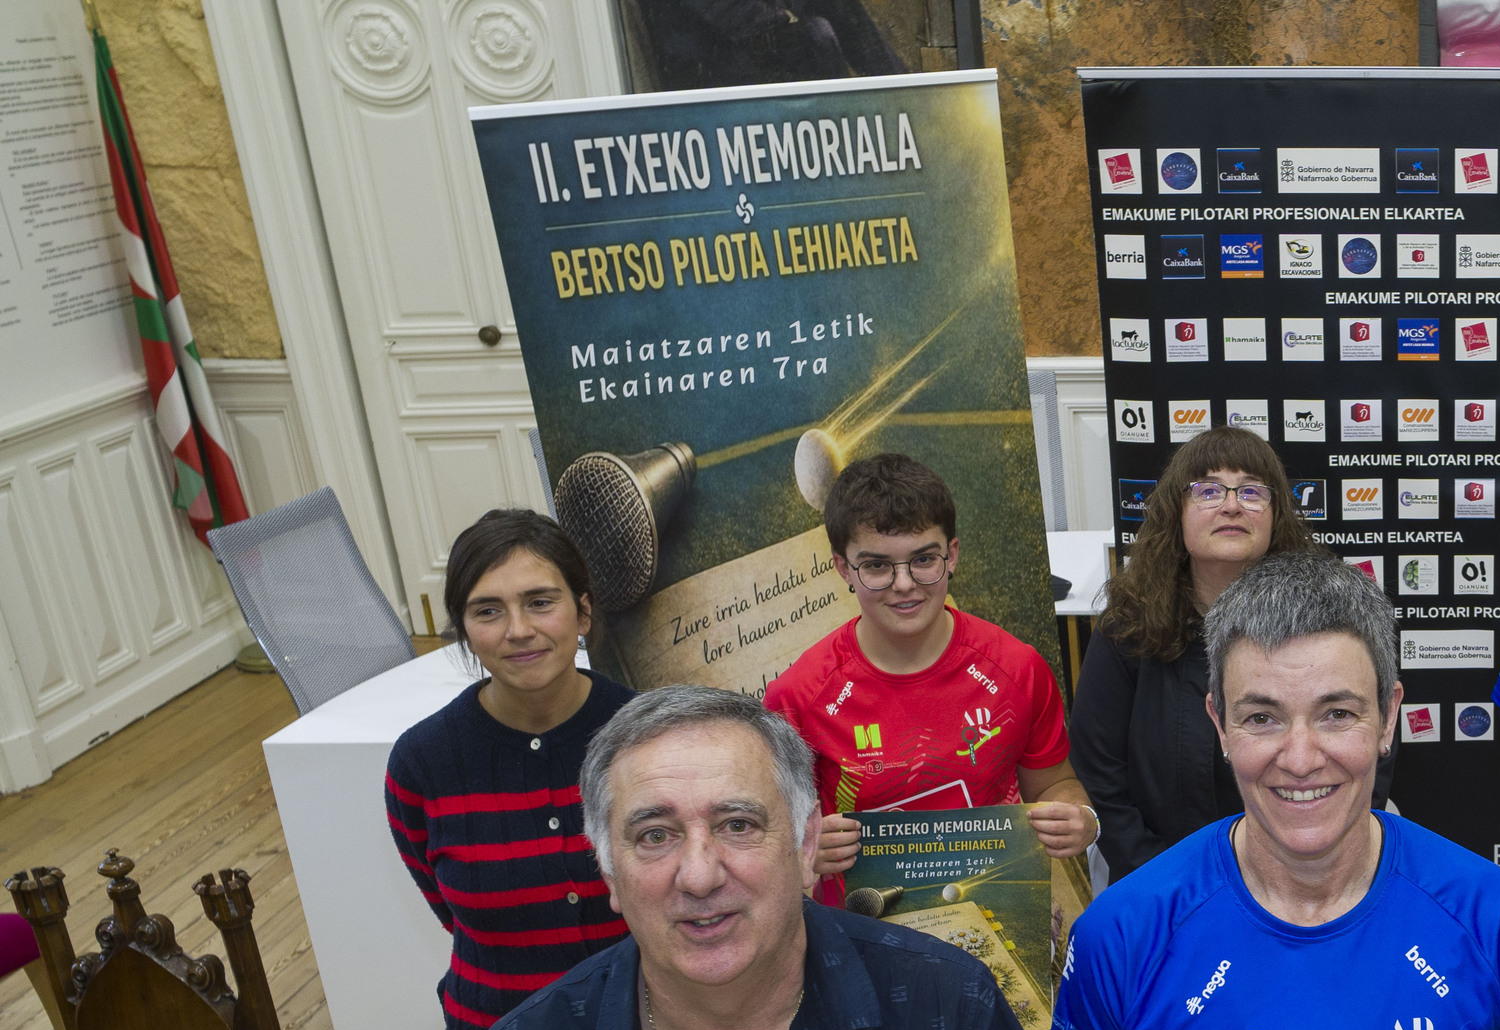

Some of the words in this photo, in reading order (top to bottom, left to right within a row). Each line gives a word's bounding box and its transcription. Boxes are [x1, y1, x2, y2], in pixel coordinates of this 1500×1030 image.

[529, 142, 571, 203] II.
[573, 129, 711, 200] ETXEKO
[716, 112, 922, 187] MEMORIALA
[1219, 171, 1260, 182] CaixaBank
[1297, 174, 1339, 182] Nafarroako
[1341, 174, 1378, 182] Gobernua
[1397, 172, 1437, 182] CaixaBank
[1102, 208, 1177, 221] EMAKUME
[1180, 207, 1249, 221] PILOTARI
[1253, 207, 1380, 220] PROFESIONALEN
[1384, 208, 1465, 220] ELKARTEA
[551, 241, 665, 299] BERTSO
[670, 230, 769, 286] PILOTA
[773, 217, 918, 276] LEHIAKETA
[1107, 251, 1144, 264] berria
[1325, 292, 1400, 304] EMAKUME
[1404, 292, 1471, 305] PILOTARI
[570, 327, 771, 370] Maiatzaren
[789, 312, 875, 345] 1etik
[579, 364, 755, 403] Ekainaren
[772, 353, 828, 380] 7ra
[1329, 454, 1402, 466] EMAKUME
[1406, 454, 1470, 466] PILOTARI
[1388, 531, 1463, 543] ELKARTEA
[670, 616, 711, 645] Zure
[715, 597, 750, 623] irria
[753, 569, 806, 605] hedatu
[1407, 607, 1470, 618] PILOTARI
[703, 640, 734, 664] lore
[737, 617, 787, 648] hauen
[790, 592, 838, 623] artean
[966, 663, 999, 695] berria
[836, 680, 854, 706] negua
[862, 825, 875, 837] II.
[879, 823, 929, 837] ETXEKO
[933, 818, 1012, 834] MEMORIALA
[862, 843, 905, 856] BERTSO
[908, 841, 945, 854] PILOTA
[949, 839, 1006, 851] LEHIAKETA
[896, 859, 961, 870] Maiatzaren
[965, 857, 995, 866] 1etik
[904, 869, 962, 879] Ekainaren
[968, 867, 986, 875] 7ra
[1201, 959, 1232, 1000] negua
[1405, 945, 1449, 998] berria
